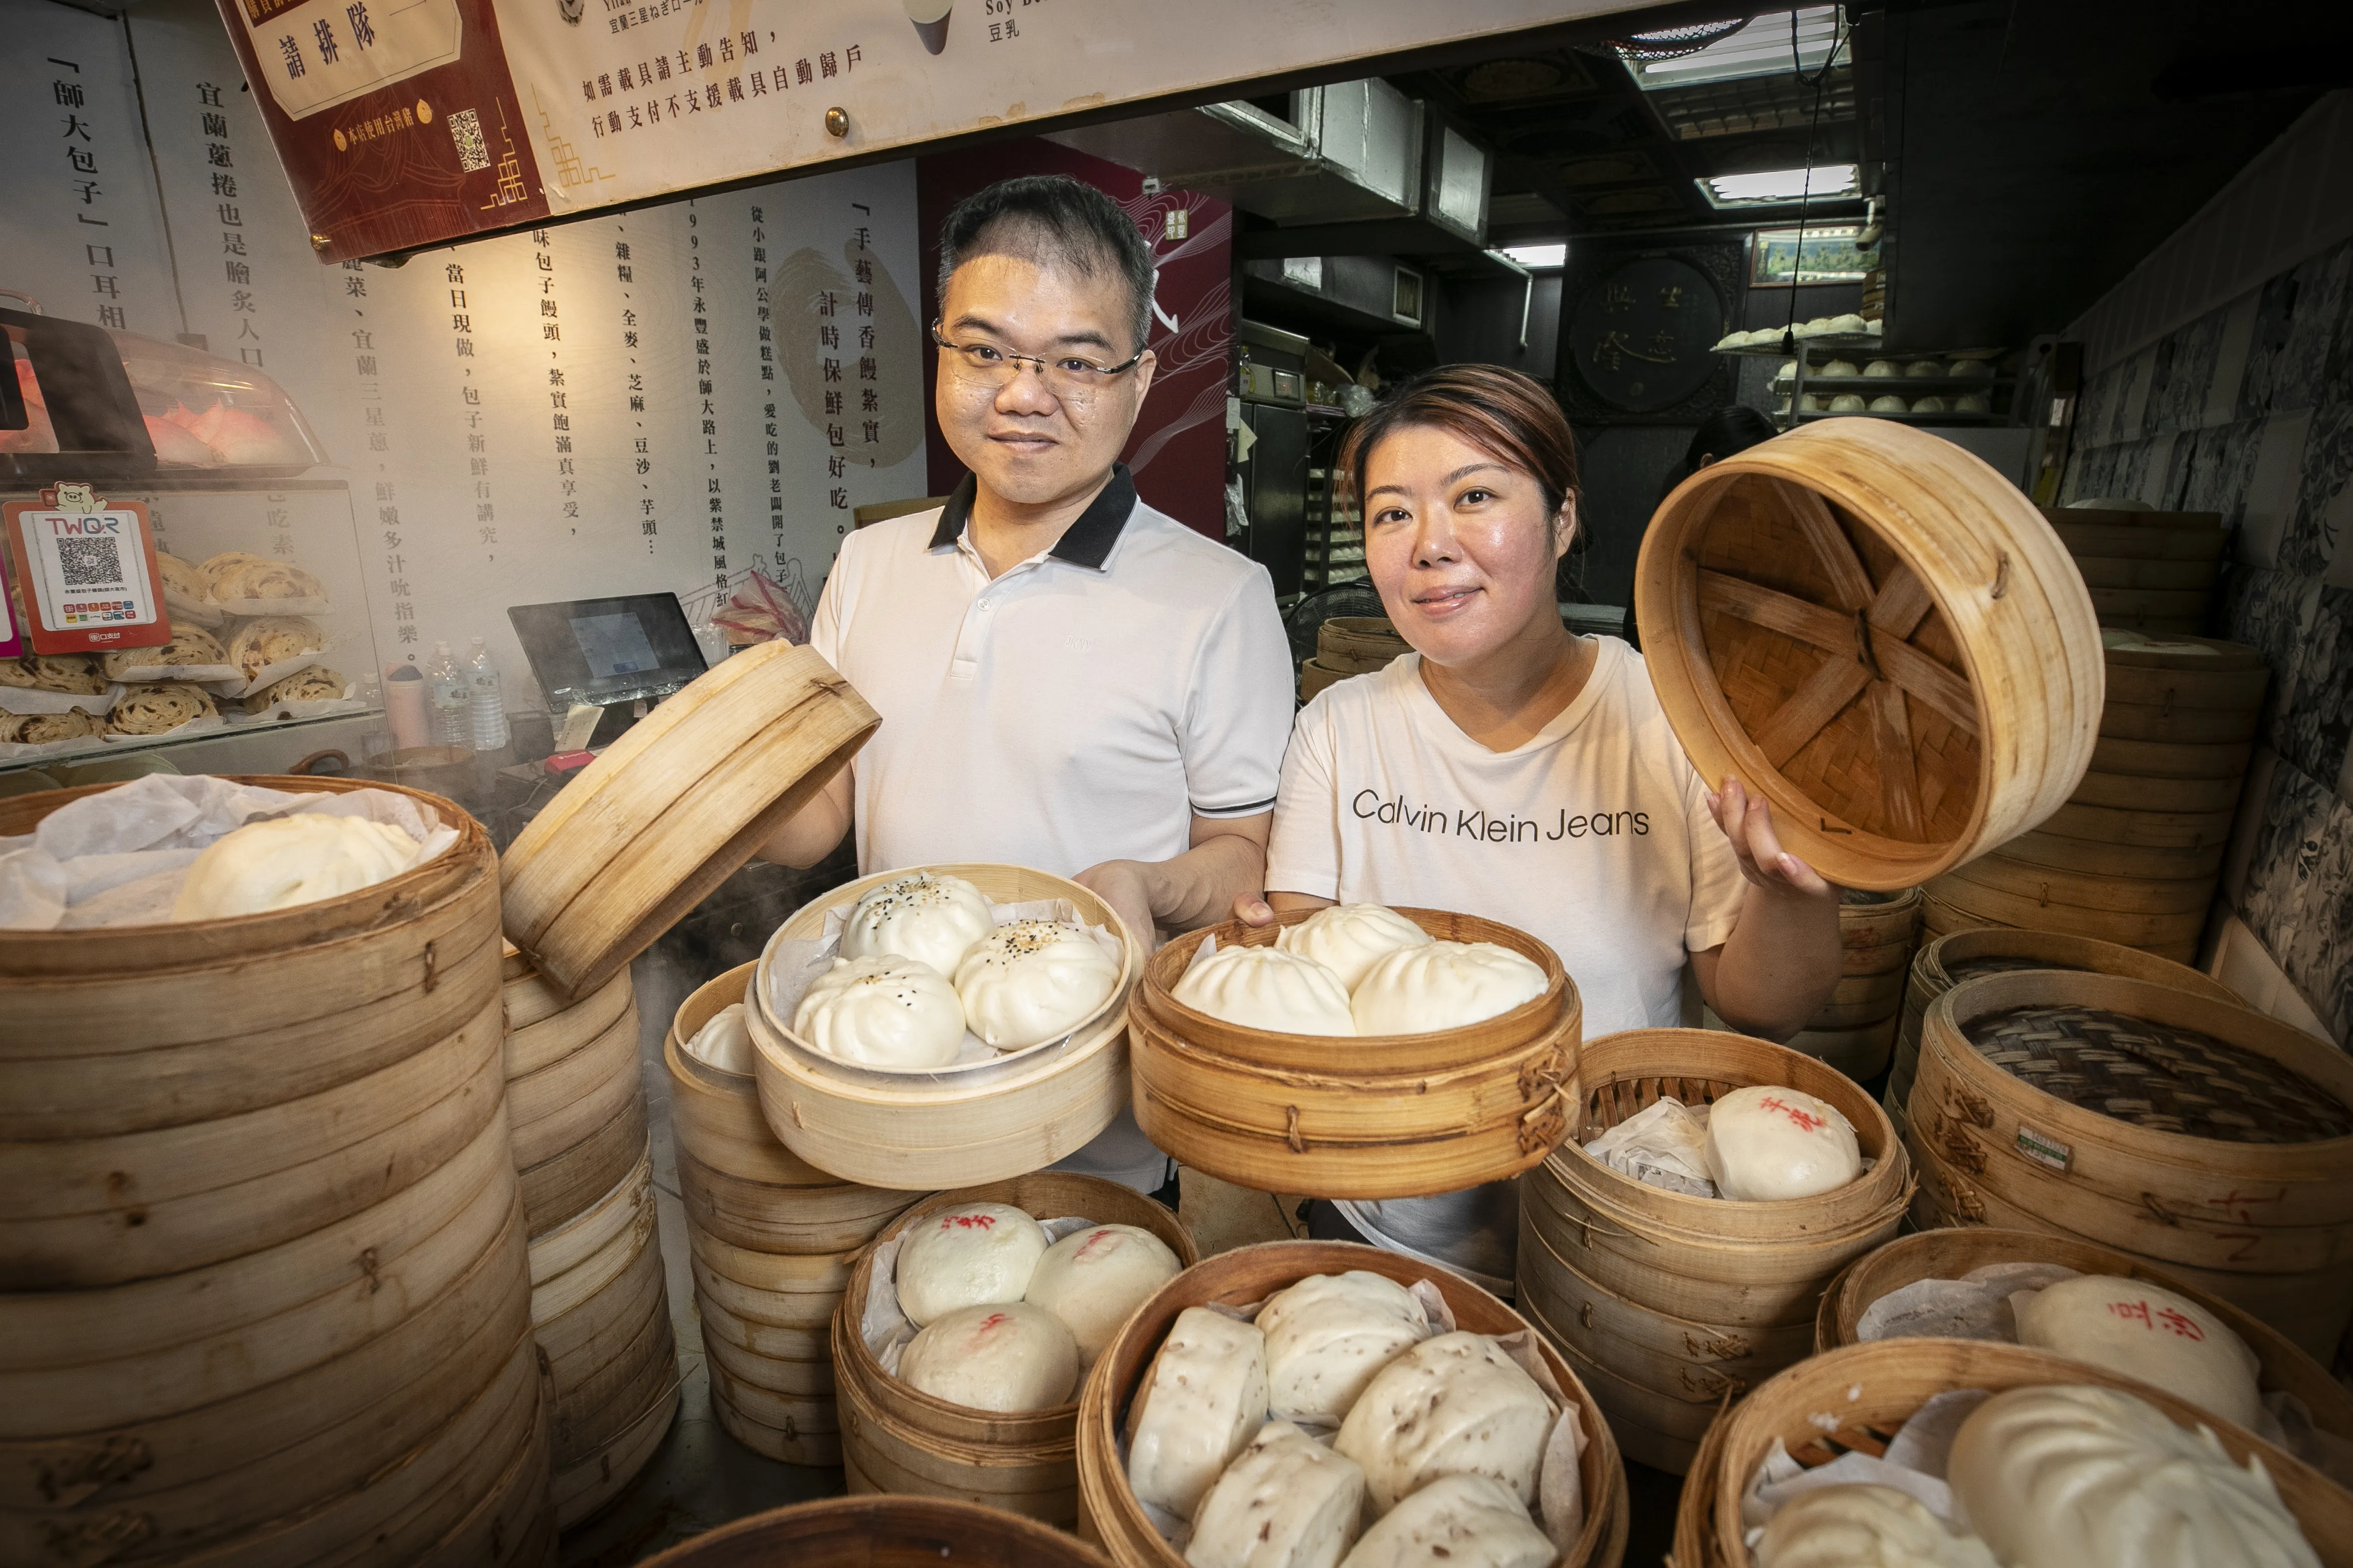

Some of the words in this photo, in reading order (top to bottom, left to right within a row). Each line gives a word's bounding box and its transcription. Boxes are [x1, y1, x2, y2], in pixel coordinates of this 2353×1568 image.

[279, 1, 375, 80] 請排隊
[989, 19, 1019, 42] 豆乳
[591, 44, 861, 139] 行動支付不支援載具自動歸戶
[45, 517, 120, 535] TWQR
[1353, 789, 1447, 834] Calvin
[1456, 809, 1538, 842] Klein
[1546, 808, 1649, 841] Jeans
